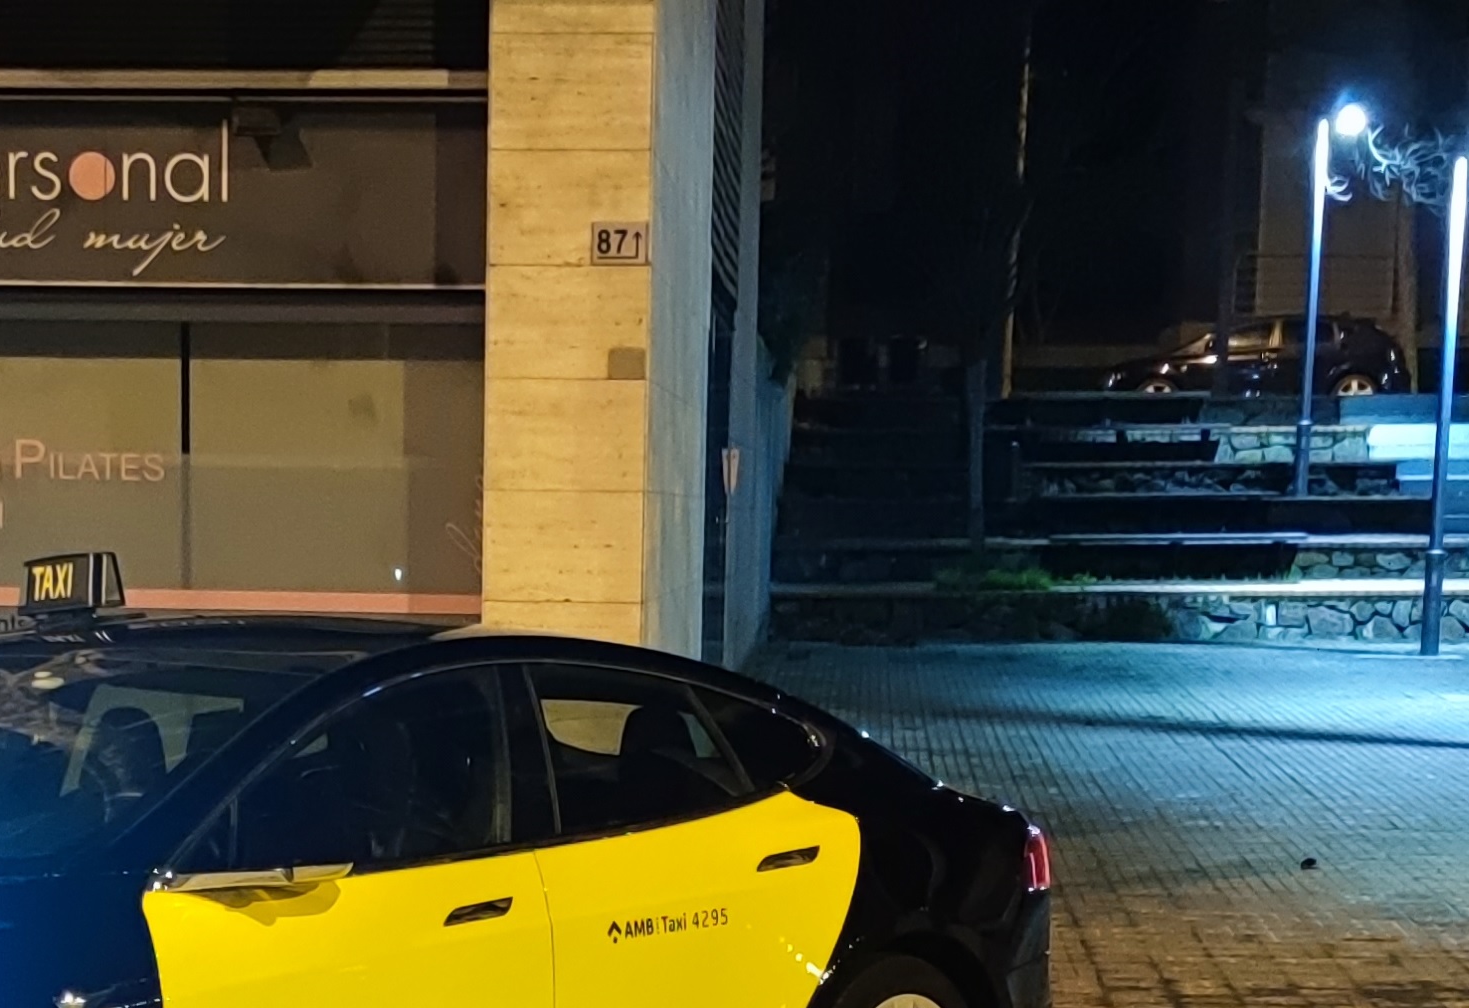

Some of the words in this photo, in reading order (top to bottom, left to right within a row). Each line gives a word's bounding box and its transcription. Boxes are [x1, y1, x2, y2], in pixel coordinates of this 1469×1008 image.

[83, 222, 227, 276] mujer
[597, 229, 628, 254] 87
[32, 561, 73, 601] TAXI
[624, 918, 654, 939] AMB
[661, 912, 687, 933] Taxi
[692, 908, 728, 928] 4295
